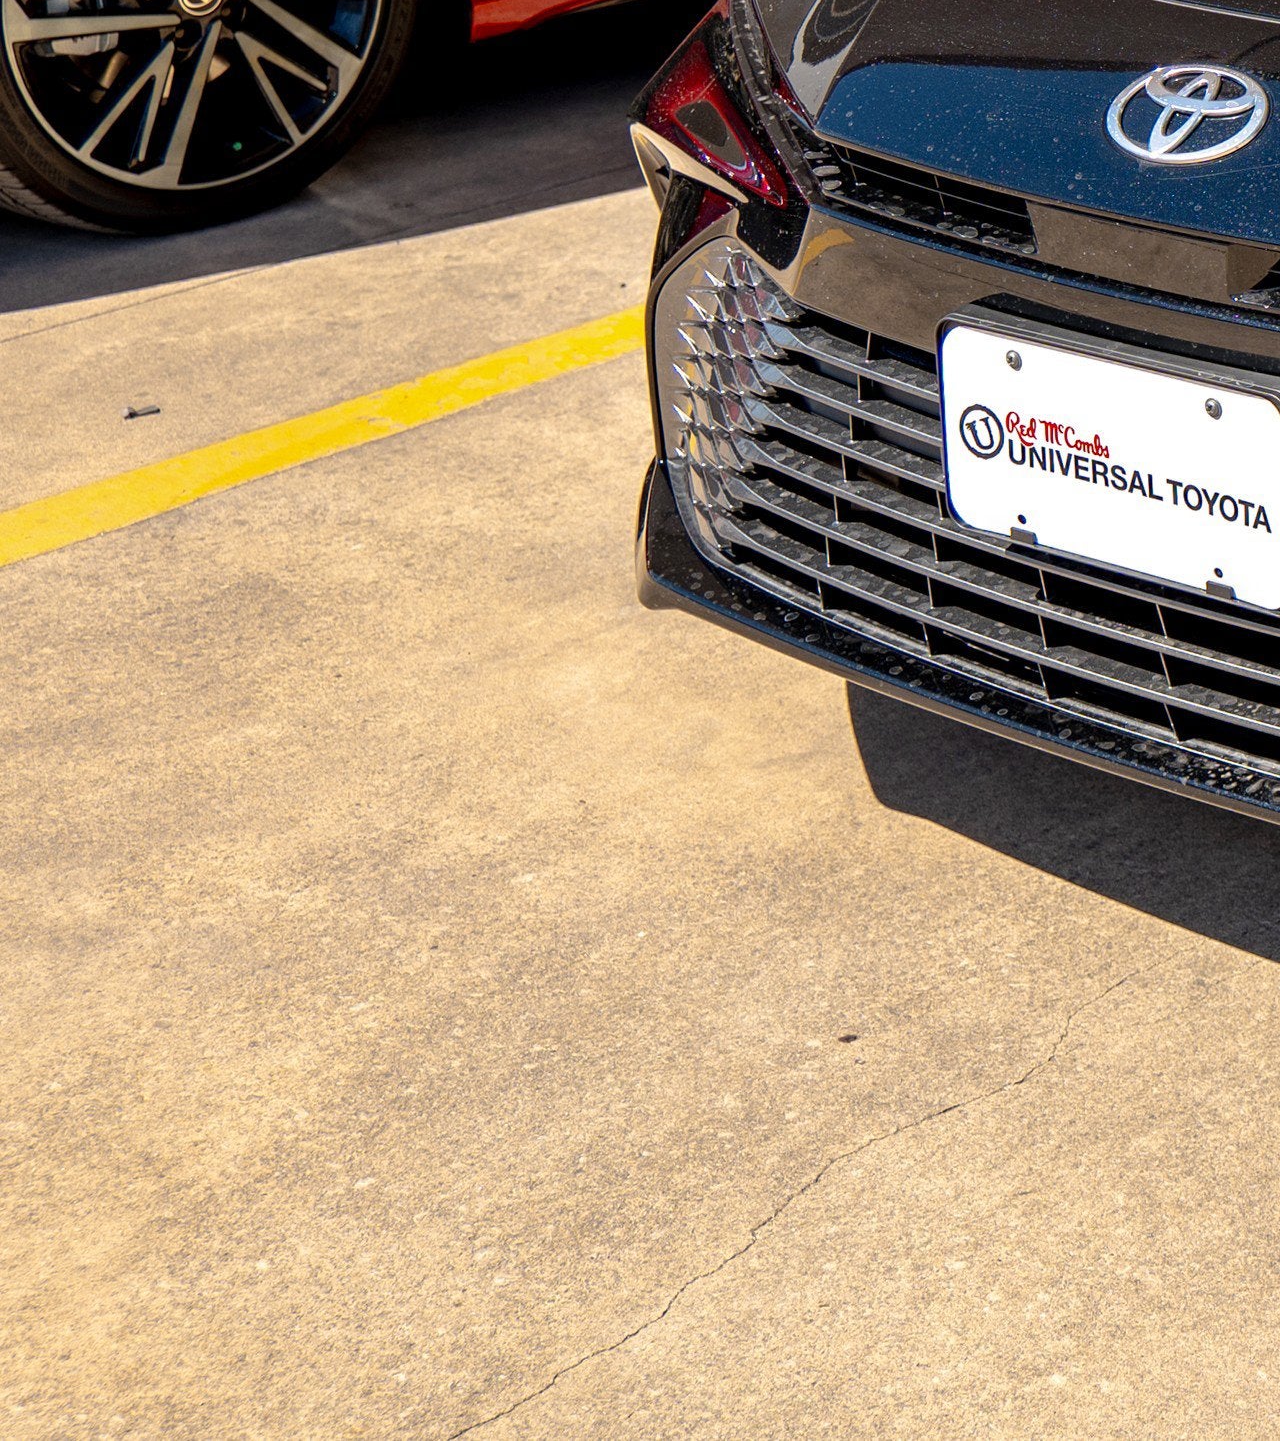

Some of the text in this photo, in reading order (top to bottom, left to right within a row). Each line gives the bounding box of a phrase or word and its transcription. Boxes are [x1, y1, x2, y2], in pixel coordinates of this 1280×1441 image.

[1006, 411, 1037, 447] Red
[1008, 438, 1272, 534] UNIVERSAL TOYOTA
